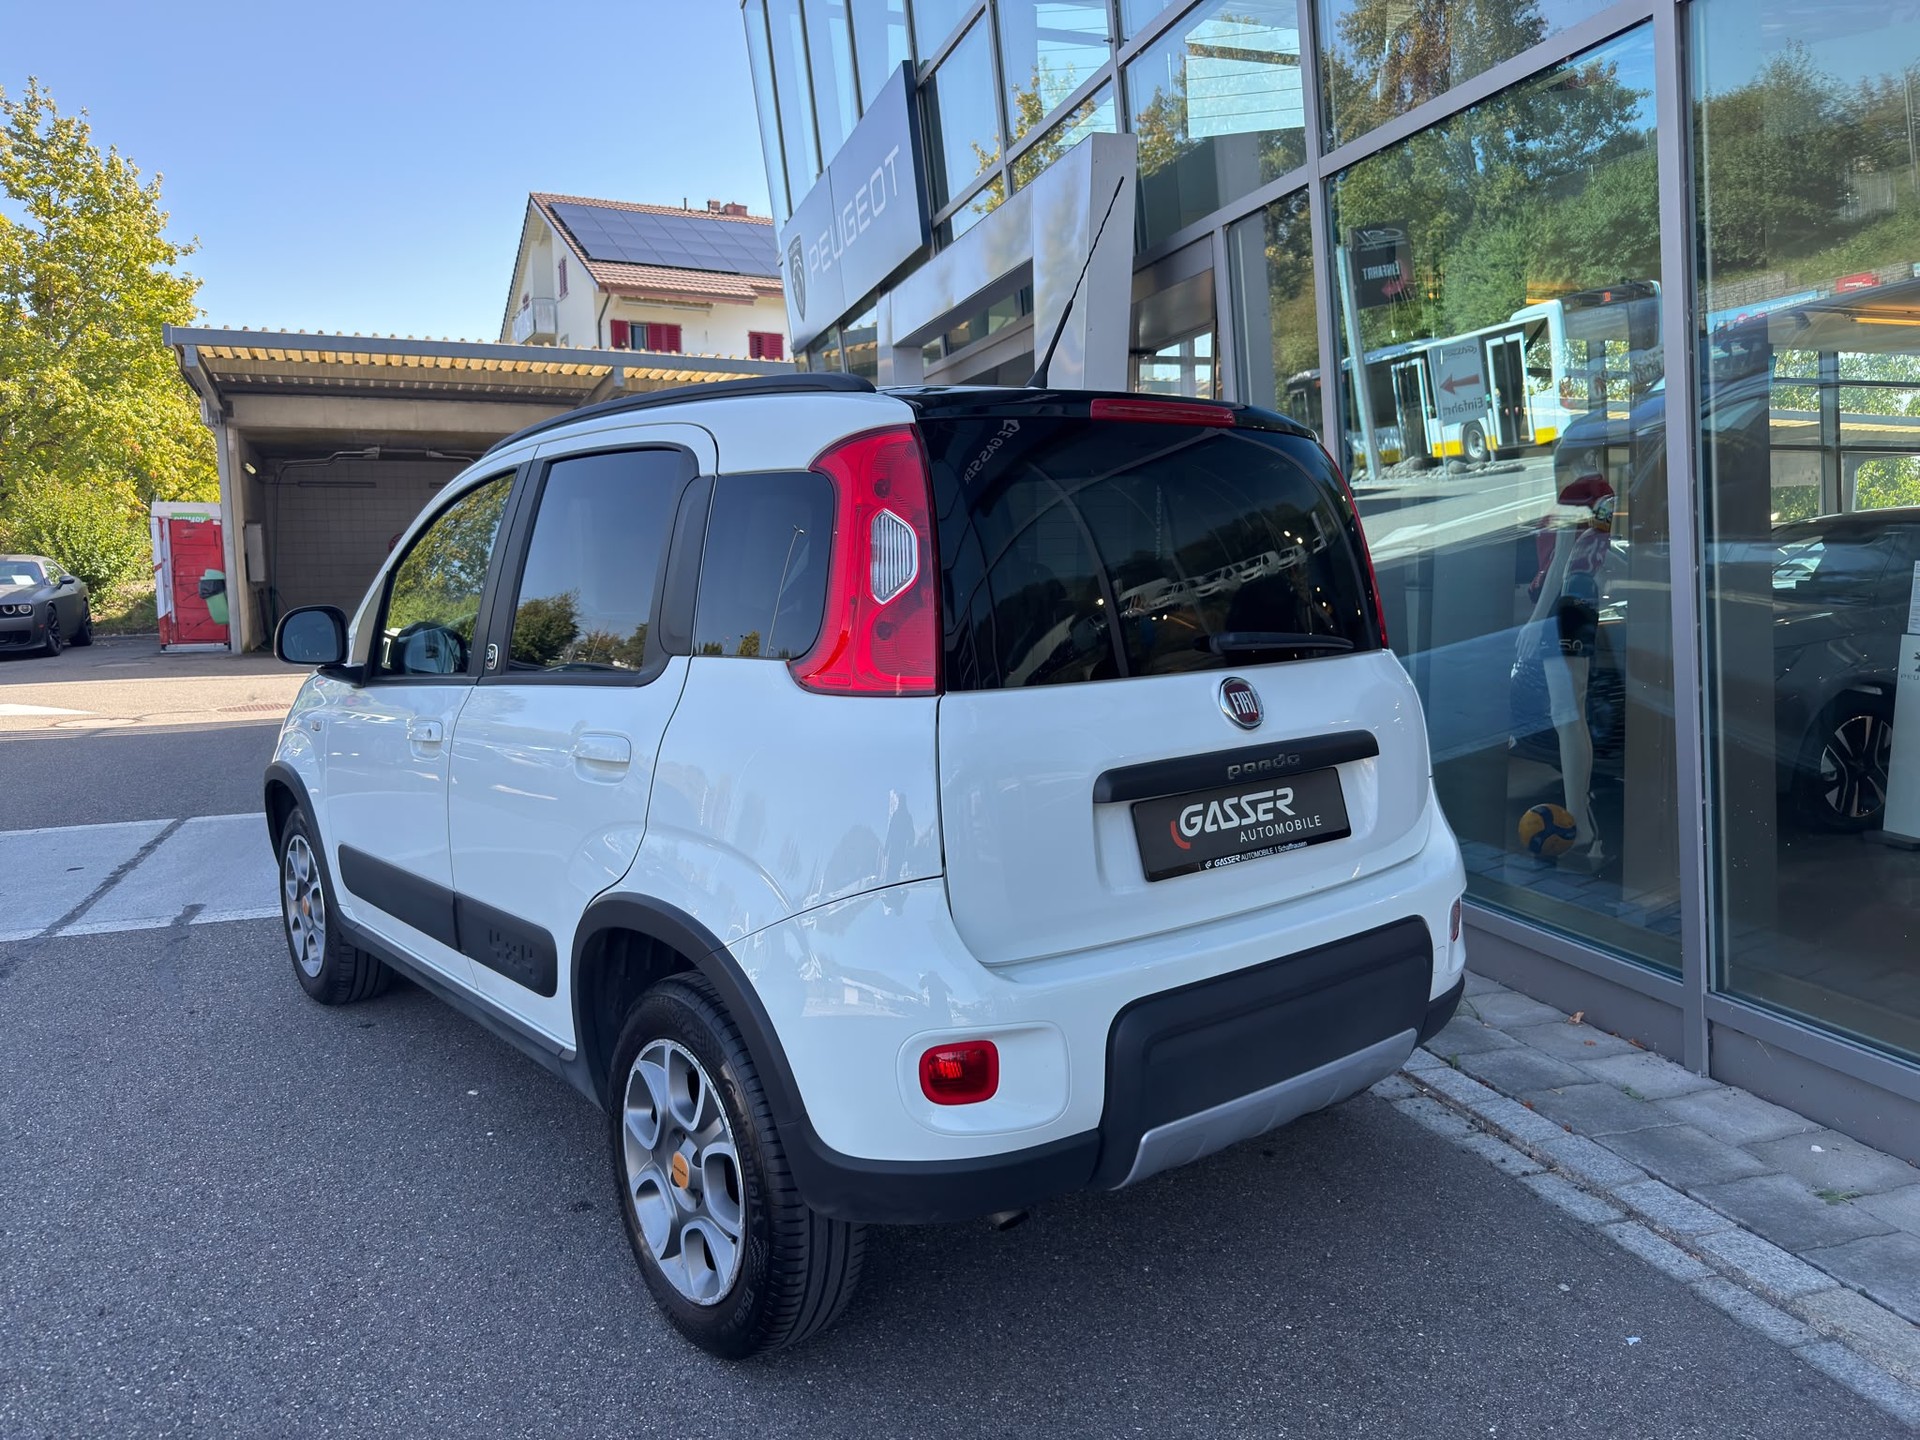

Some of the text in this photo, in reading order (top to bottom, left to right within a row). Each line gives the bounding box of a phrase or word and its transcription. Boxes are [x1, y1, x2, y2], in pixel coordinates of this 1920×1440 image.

[807, 144, 900, 285] PEUGEOT
[1229, 690, 1258, 715] FIAT
[1226, 752, 1301, 781] panda
[1179, 787, 1296, 838] GASSER
[1239, 815, 1322, 843] AUTOMOBILE
[1214, 855, 1241, 867] GASSER
[1240, 849, 1274, 861] AUTOMOBILE
